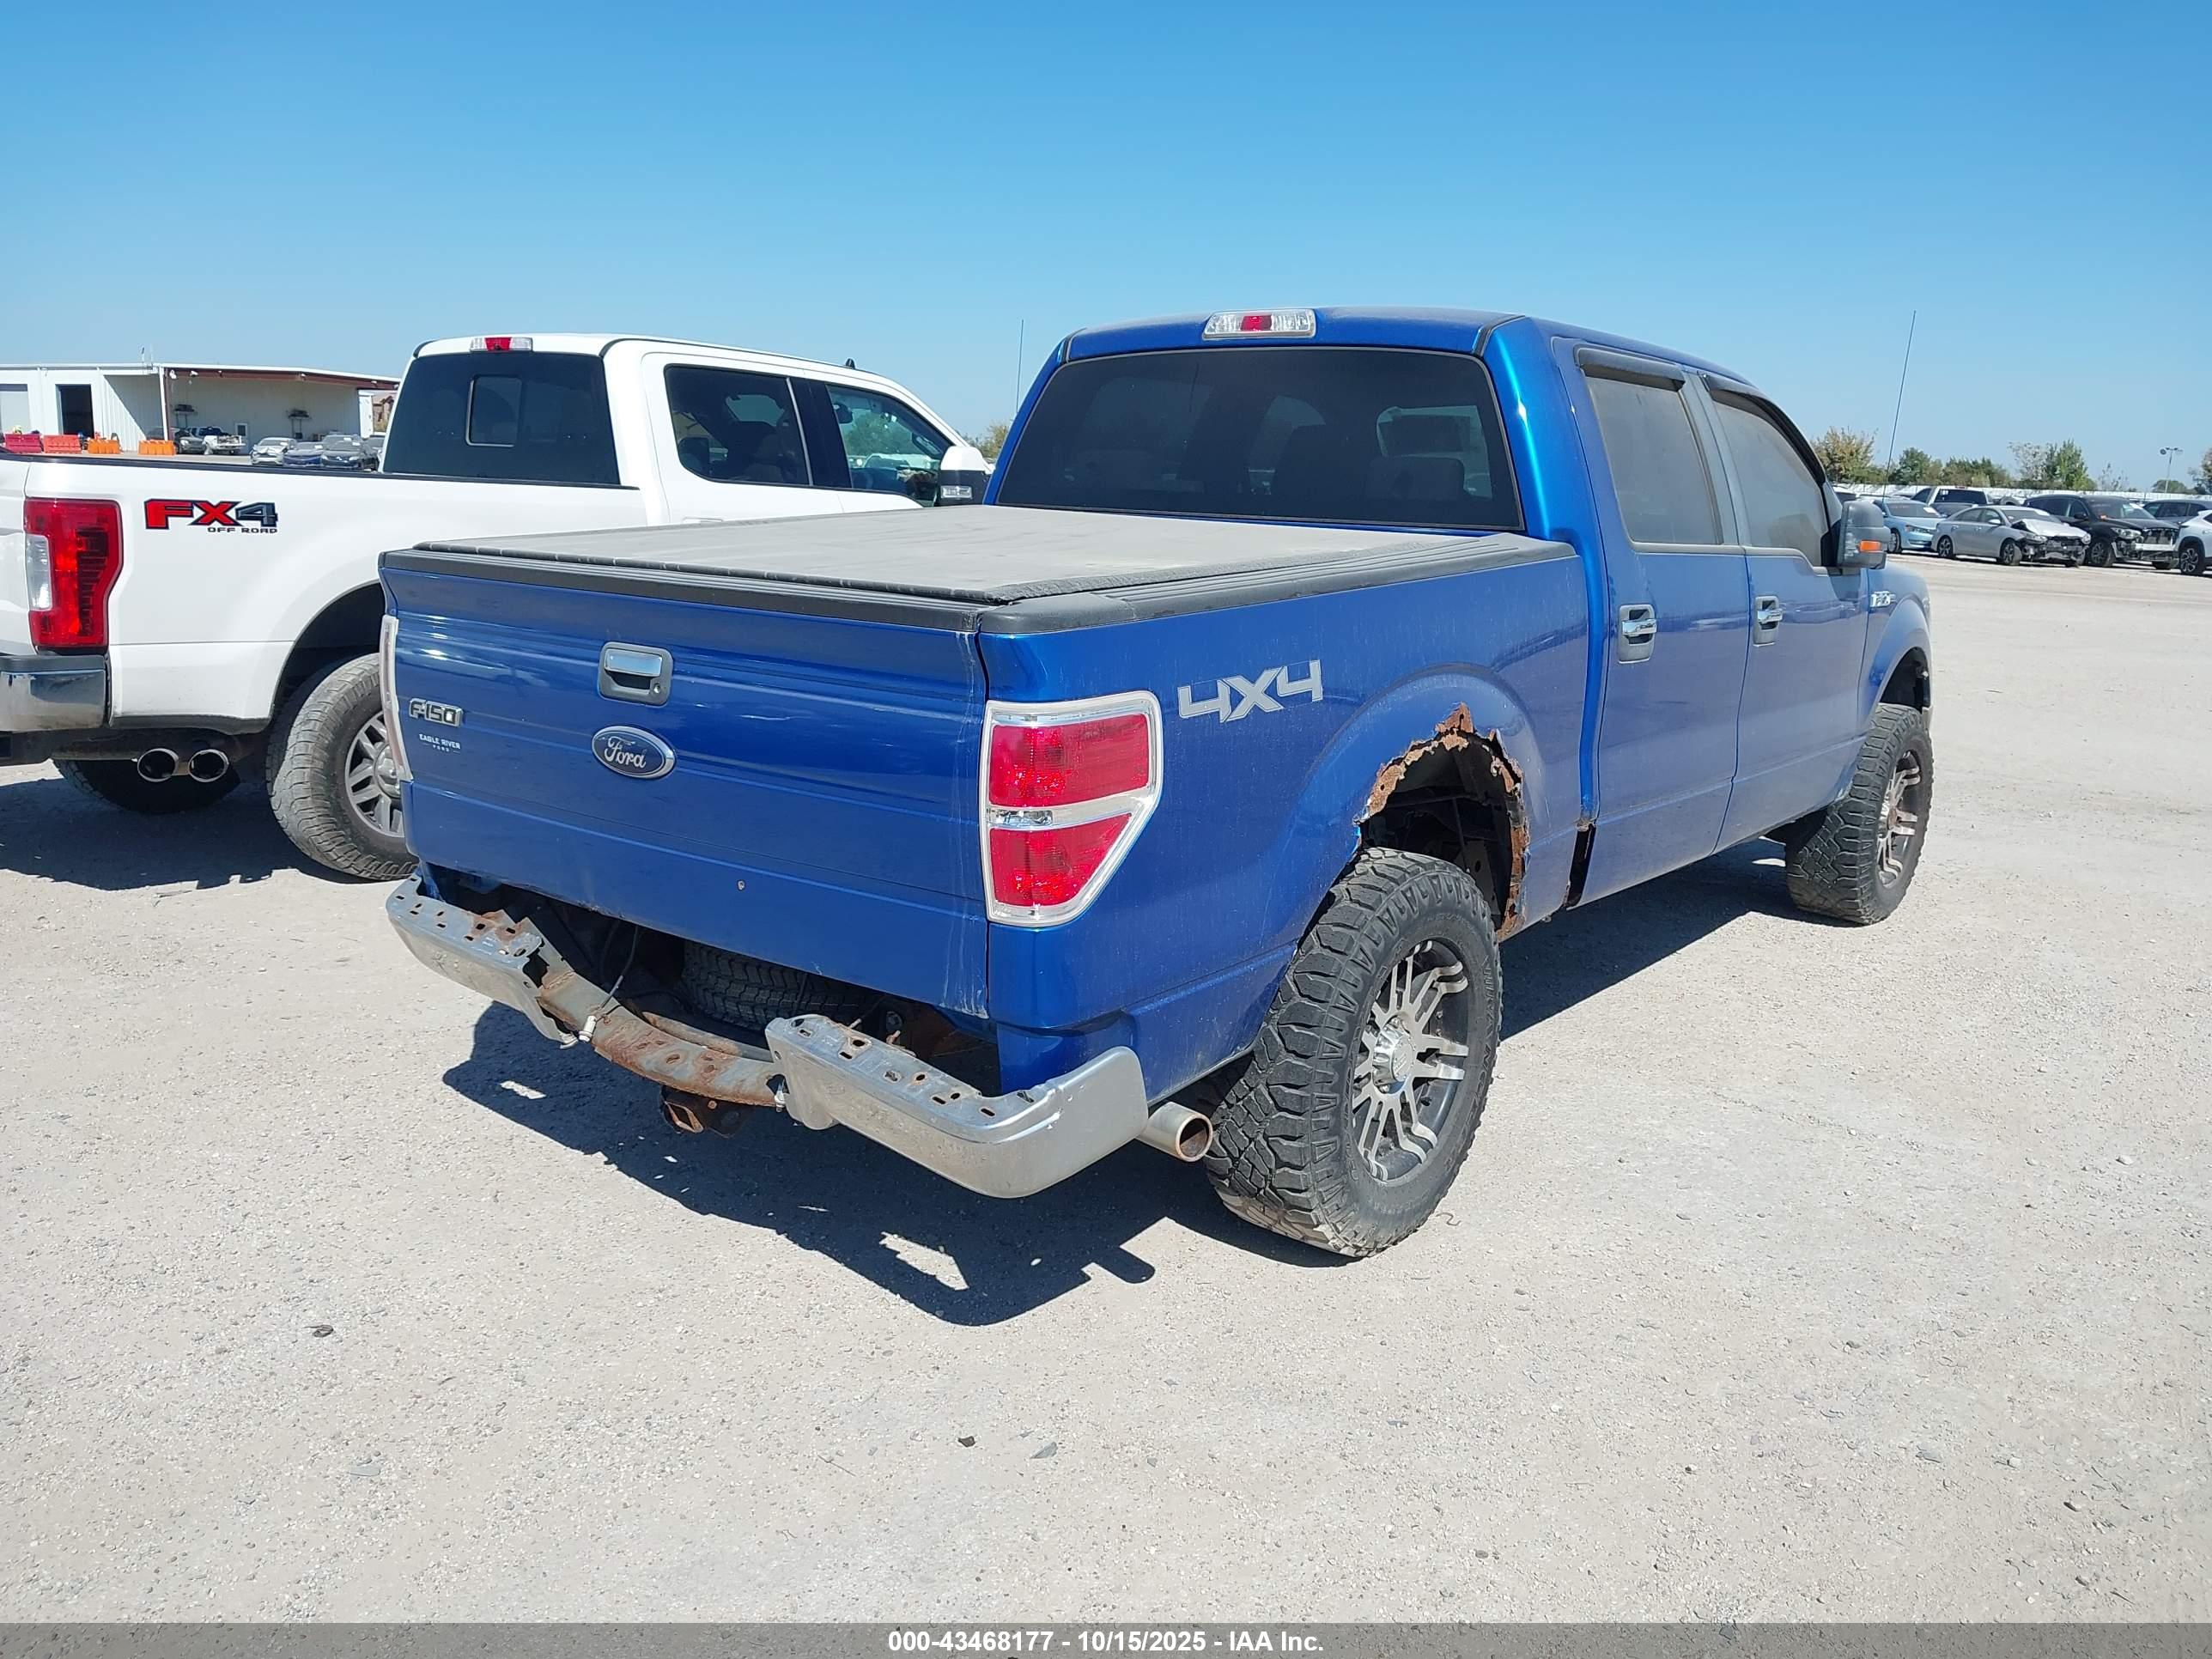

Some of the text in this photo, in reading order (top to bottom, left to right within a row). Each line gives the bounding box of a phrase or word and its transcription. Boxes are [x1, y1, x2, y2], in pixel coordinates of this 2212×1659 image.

[144, 498, 277, 529] FX4
[410, 698, 461, 727] F-150
[418, 733, 461, 749] EAGLE RIVER
[604, 736, 647, 769] Ford
